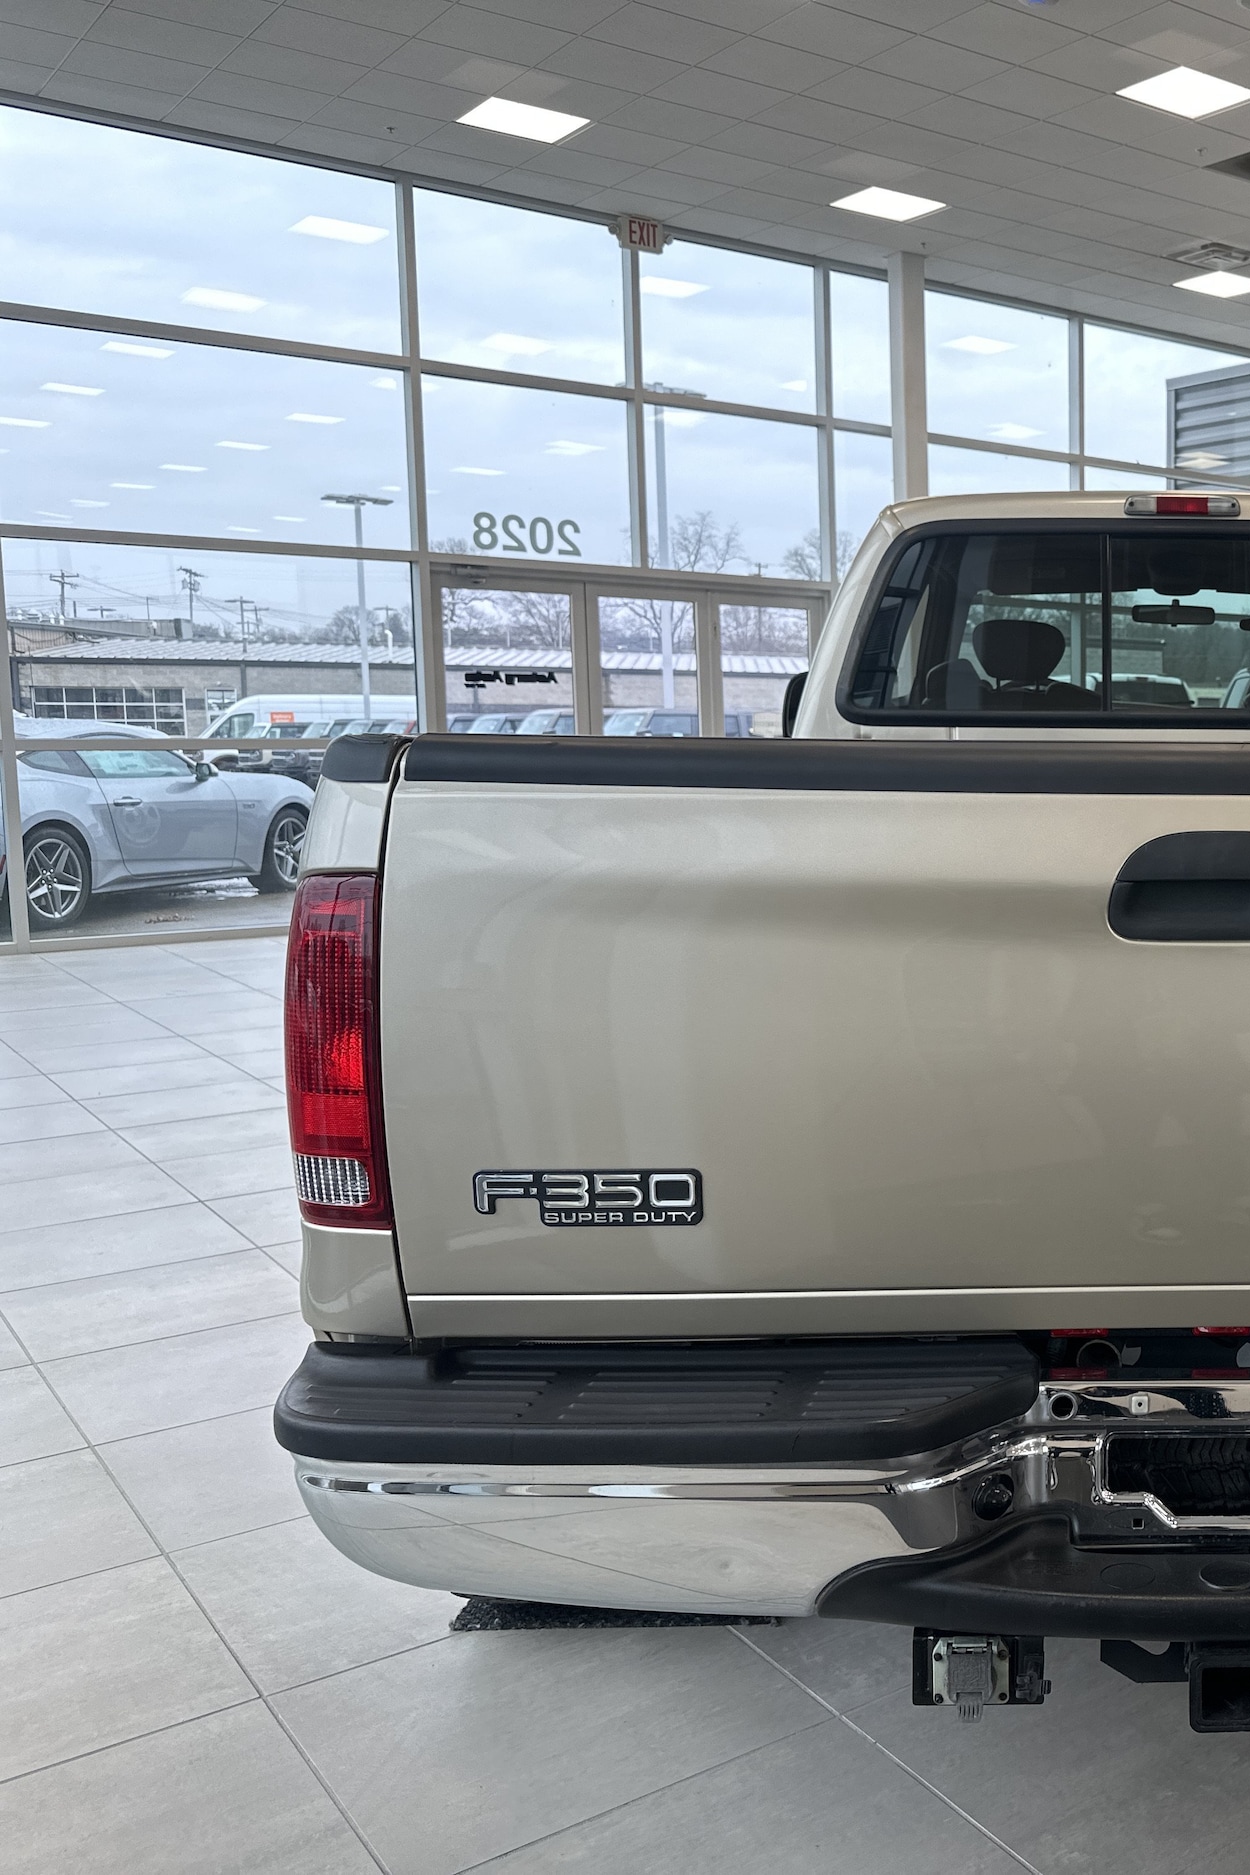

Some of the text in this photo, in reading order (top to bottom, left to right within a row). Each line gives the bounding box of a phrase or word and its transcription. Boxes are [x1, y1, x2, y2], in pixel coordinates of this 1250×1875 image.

[628, 219, 658, 248] EXIT
[544, 1211, 697, 1224] SUPER DUTY
